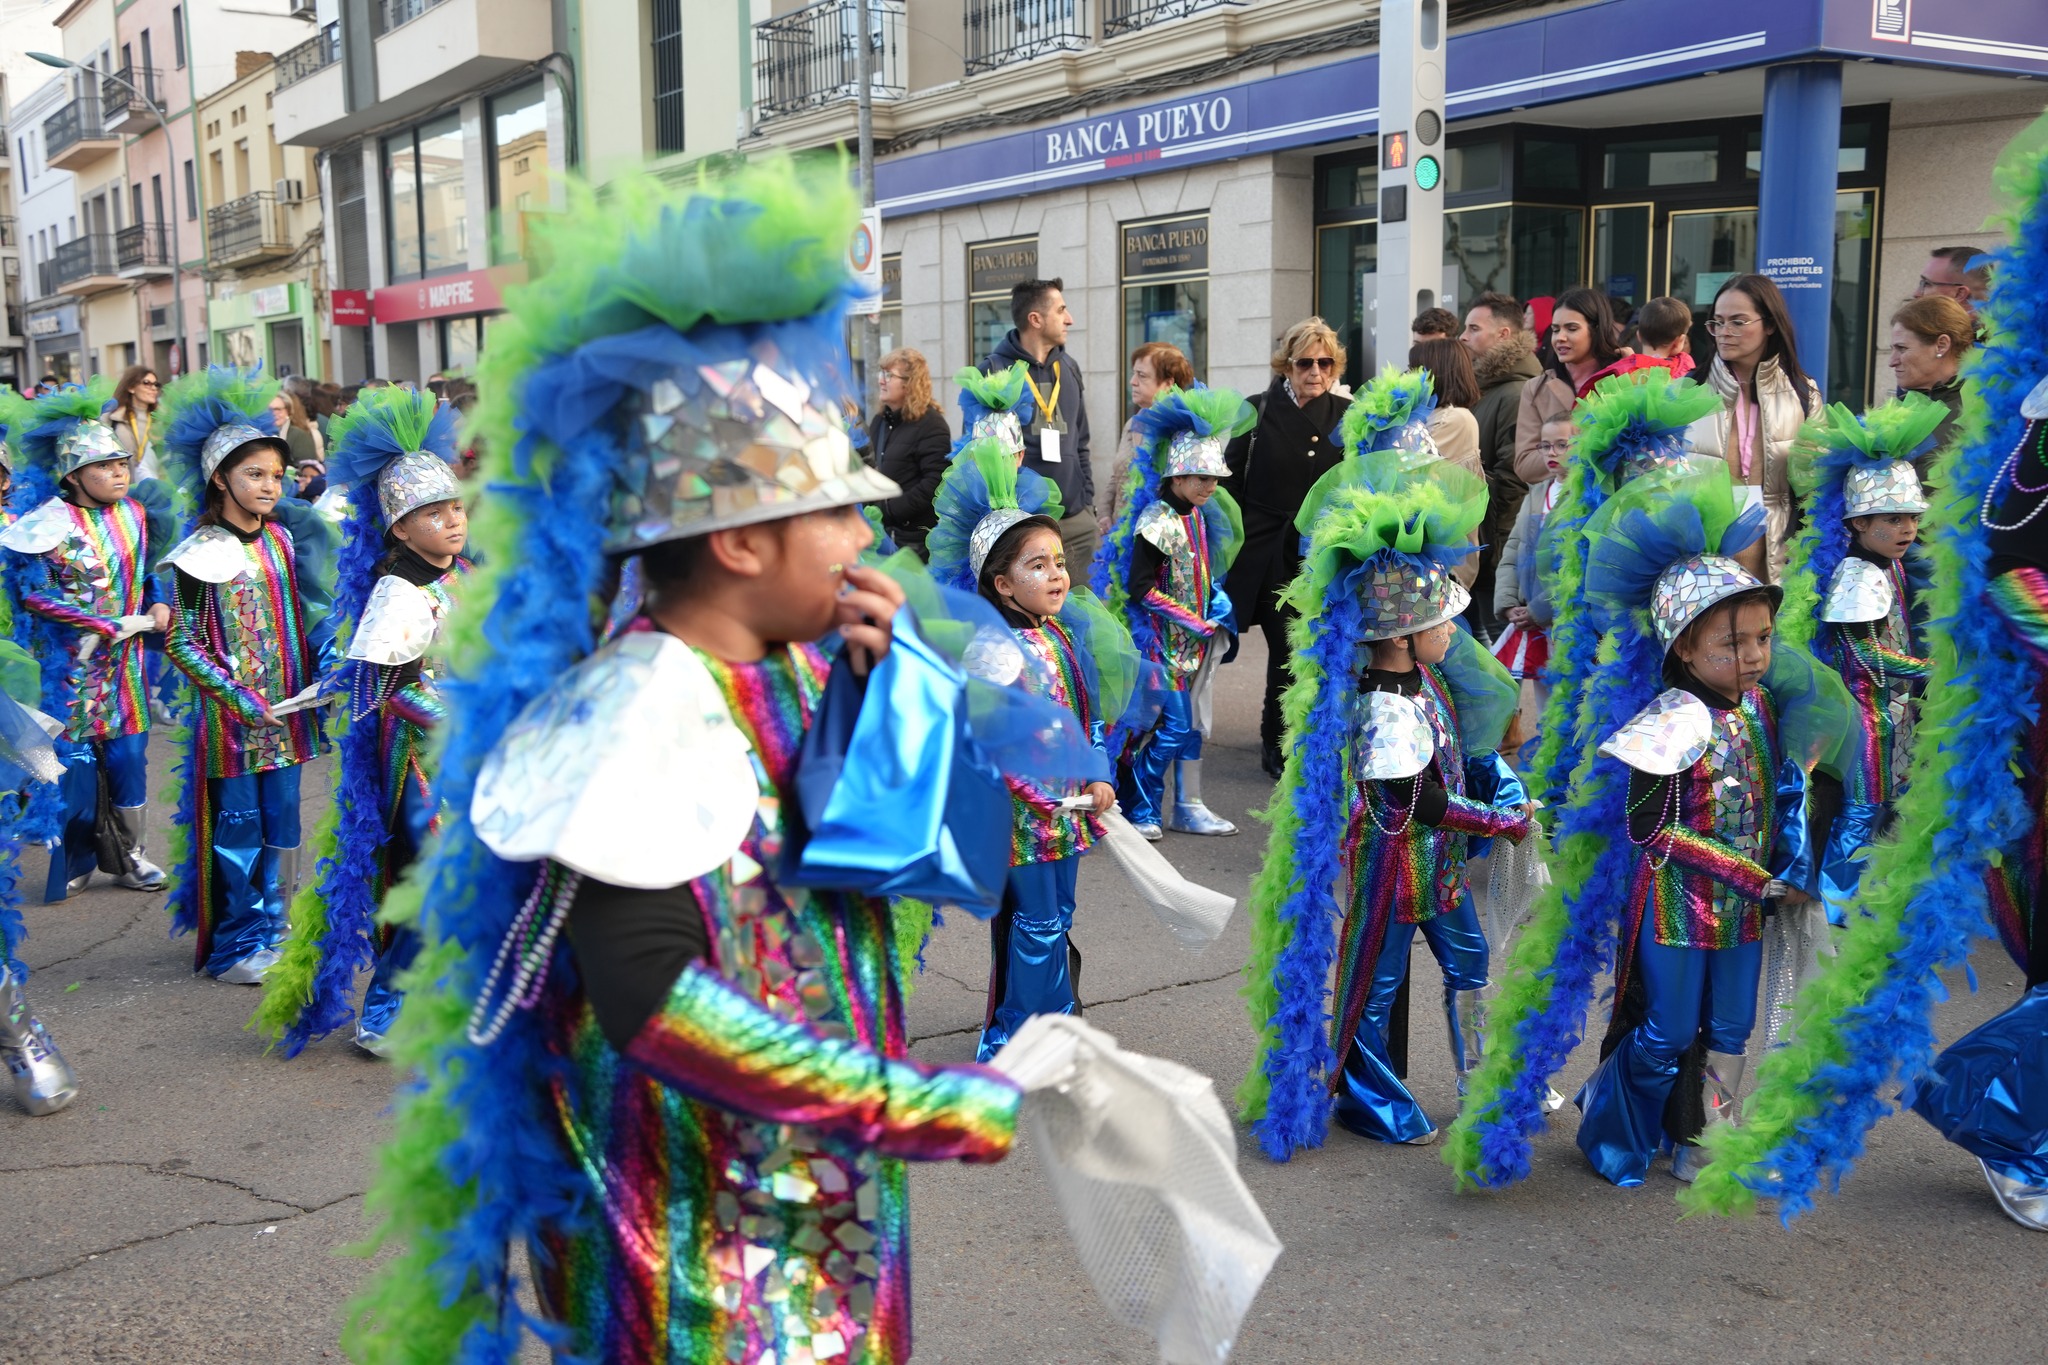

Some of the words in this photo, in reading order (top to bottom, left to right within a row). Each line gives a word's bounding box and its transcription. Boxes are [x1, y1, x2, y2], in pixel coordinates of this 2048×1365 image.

[1046, 120, 1130, 164] BANCA
[1138, 97, 1231, 146] PUEYO
[1127, 232, 1167, 253] BANCA
[1168, 228, 1207, 249] PUEYO
[974, 254, 1005, 272] BANCA
[1006, 250, 1037, 268] PUEYO
[1767, 257, 1814, 266] PROHIBIDO
[1780, 266, 1823, 275] CARTELES
[428, 280, 474, 308] MAPFRE
